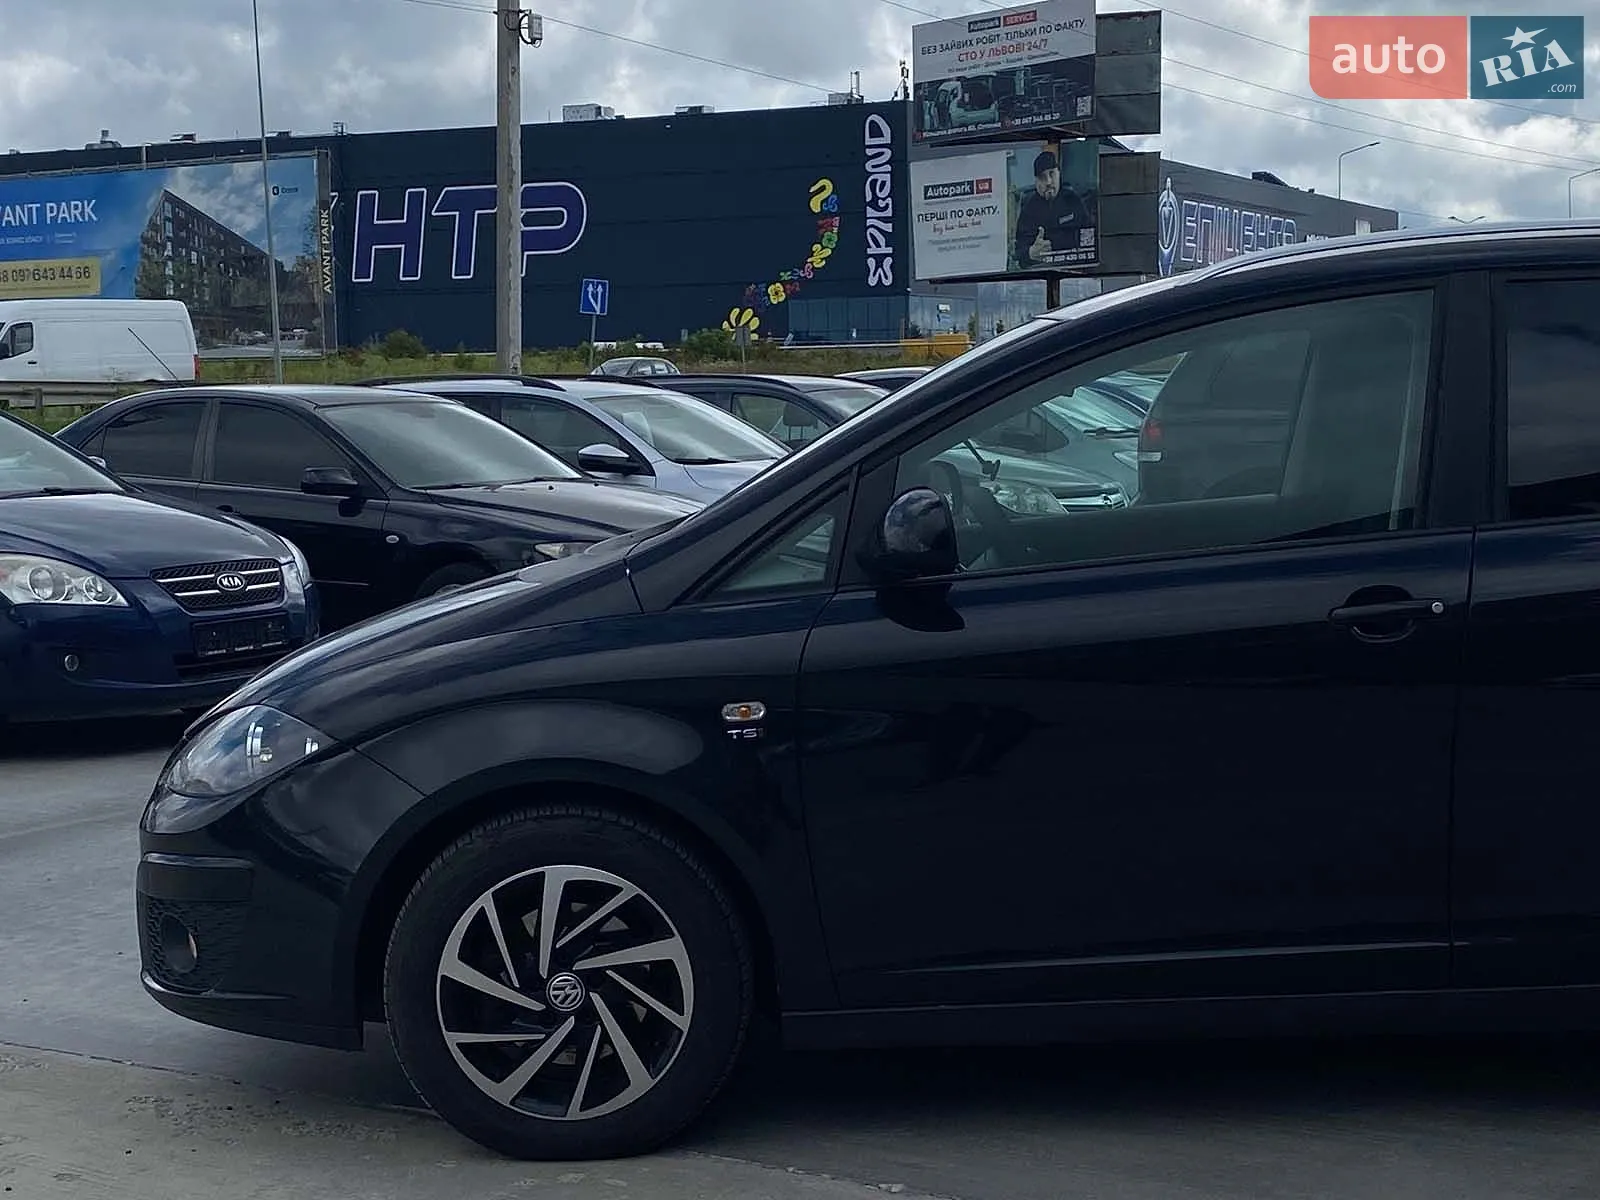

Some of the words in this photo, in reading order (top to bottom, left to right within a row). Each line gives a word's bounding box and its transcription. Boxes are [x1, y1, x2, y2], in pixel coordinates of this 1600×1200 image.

[1005, 12, 1035, 25] SERVICE
[921, 45, 937, 56] БЕЗ
[939, 38, 974, 54] ЗАЙВИХ
[1005, 28, 1038, 41] ТІЛЬКИ
[1039, 24, 1052, 35] ПО
[958, 51, 978, 63] СТО
[979, 49, 988, 60] У
[988, 42, 1025, 57] ЛЬВОВІ
[1026, 38, 1048, 51] 24/7
[864, 114, 893, 287] EPILAND
[926, 183, 972, 198] Autopark
[0, 203, 41, 227] ANT
[46, 199, 98, 225] PARK
[917, 211, 949, 223] ПЕРШІ
[950, 209, 964, 219] ПО
[320, 209, 330, 244] PARK
[330, 181, 588, 282] НТР
[32, 267, 56, 281] 643
[59, 266, 73, 280] 44
[321, 248, 333, 295] AVANT
[220, 577, 242, 588] KIA
